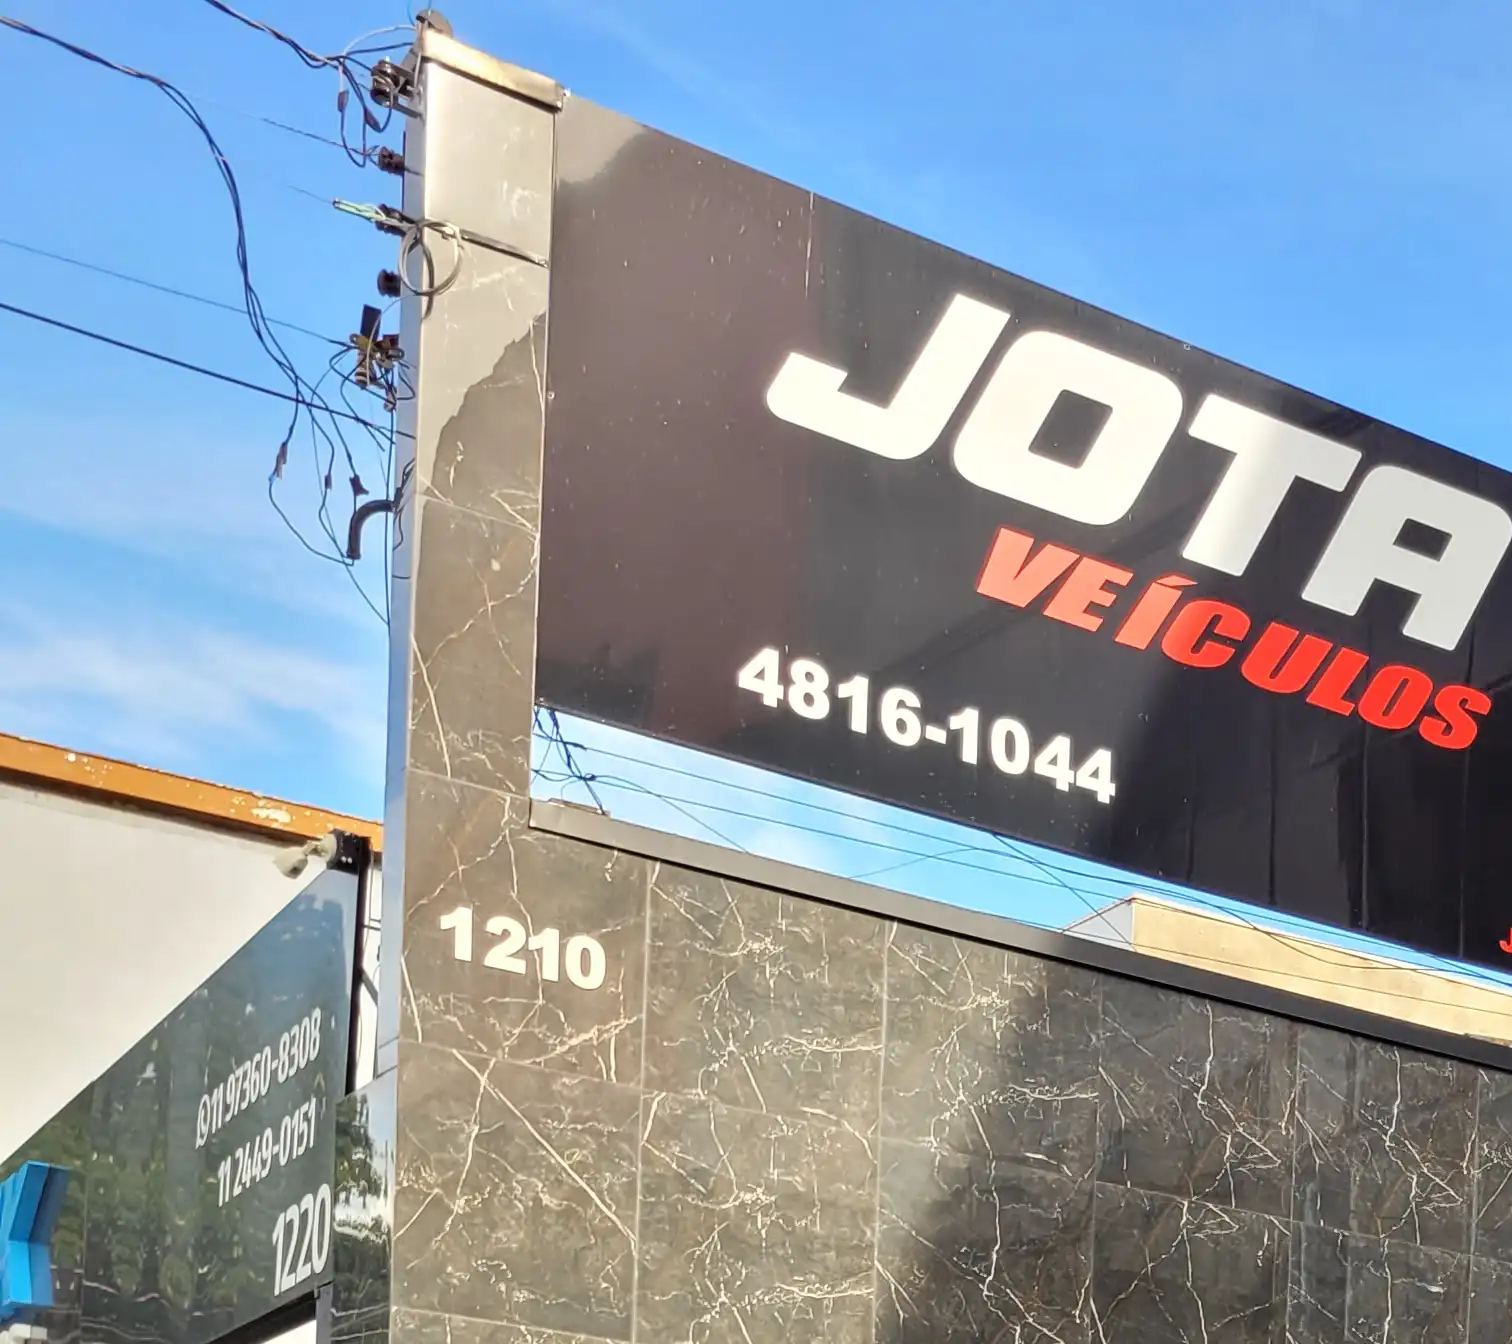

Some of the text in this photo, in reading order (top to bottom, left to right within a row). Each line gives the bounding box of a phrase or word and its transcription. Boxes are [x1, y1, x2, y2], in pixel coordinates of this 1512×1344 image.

[976, 526, 1494, 751] VEÍCULOS
[737, 646, 1116, 804] 4816-1044
[439, 906, 606, 990] 1210
[217, 1096, 317, 1208] 11 2449-0151
[272, 1183, 331, 1297] 1220
